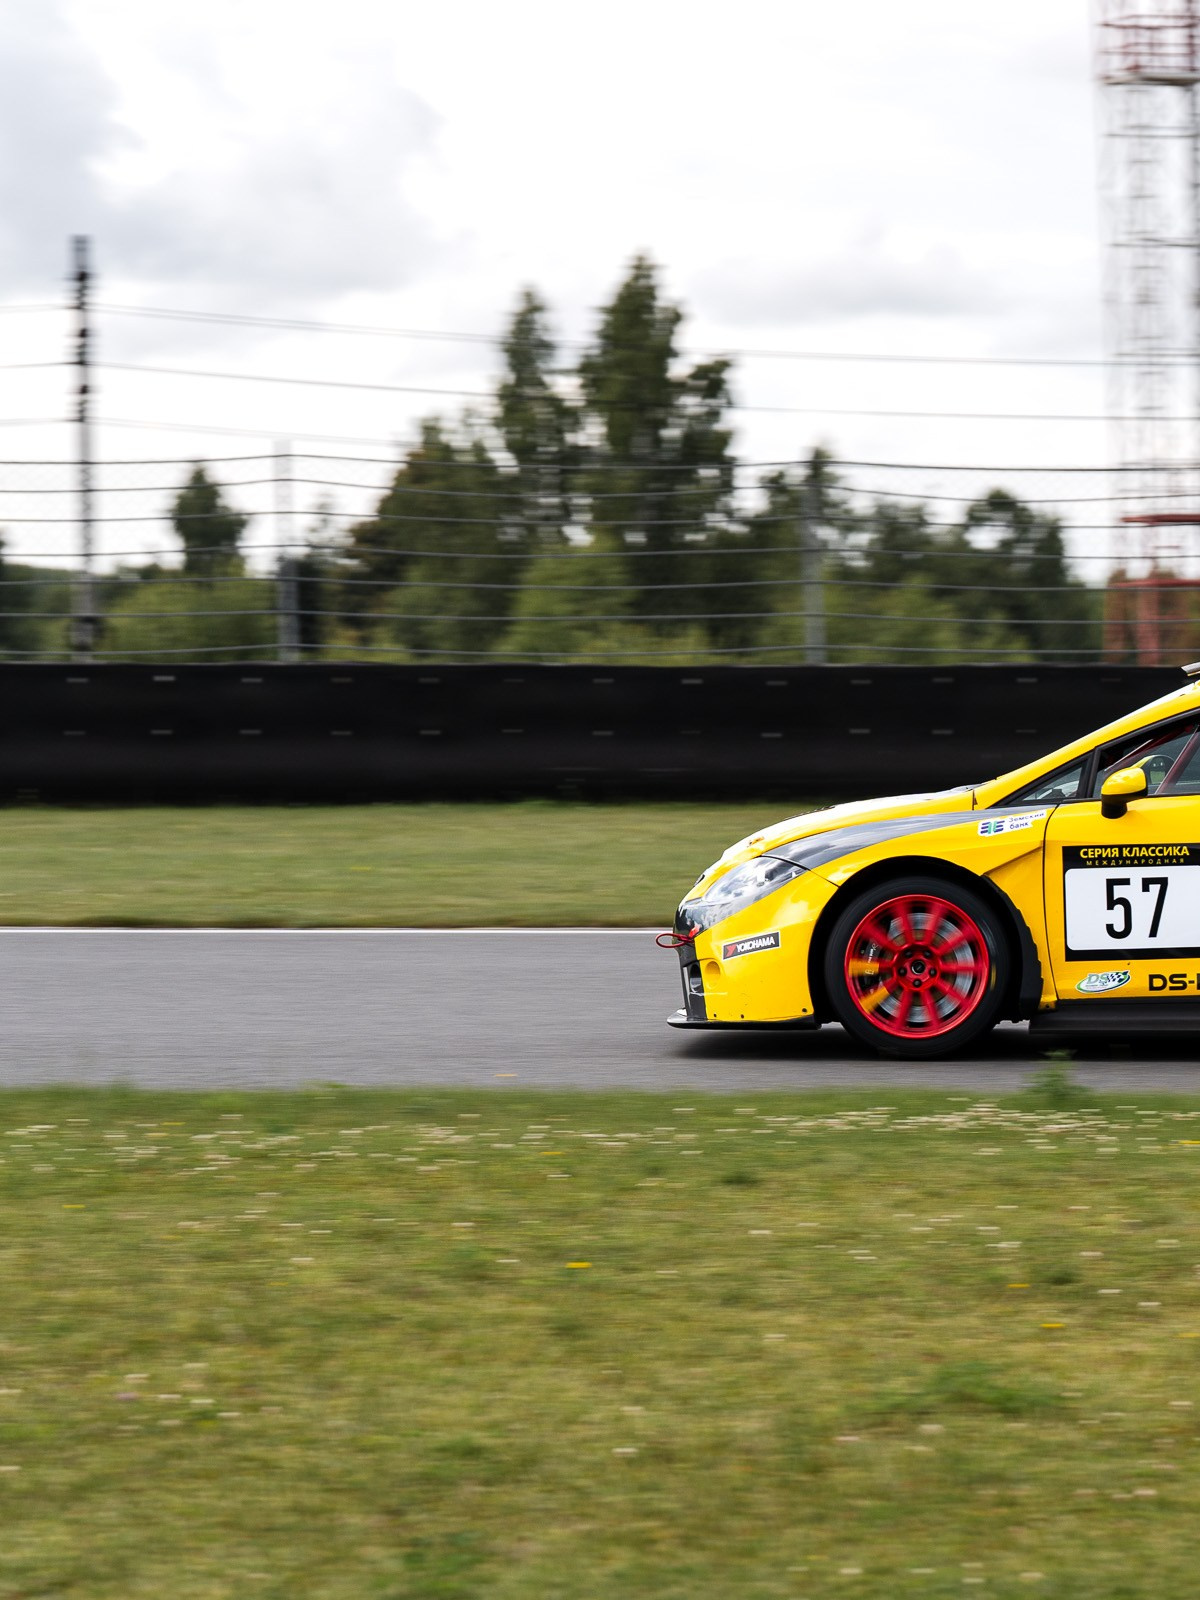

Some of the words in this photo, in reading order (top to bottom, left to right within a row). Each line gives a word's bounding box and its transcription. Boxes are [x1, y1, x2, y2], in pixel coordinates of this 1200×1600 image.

[1080, 847, 1119, 859] СЕРИЯ
[1122, 846, 1190, 858] КЛАССИКА
[1086, 858, 1185, 866] МЕЖДУНАРОДНАЯ
[1105, 876, 1169, 940] 57
[736, 936, 775, 952] YOKOHAMA
